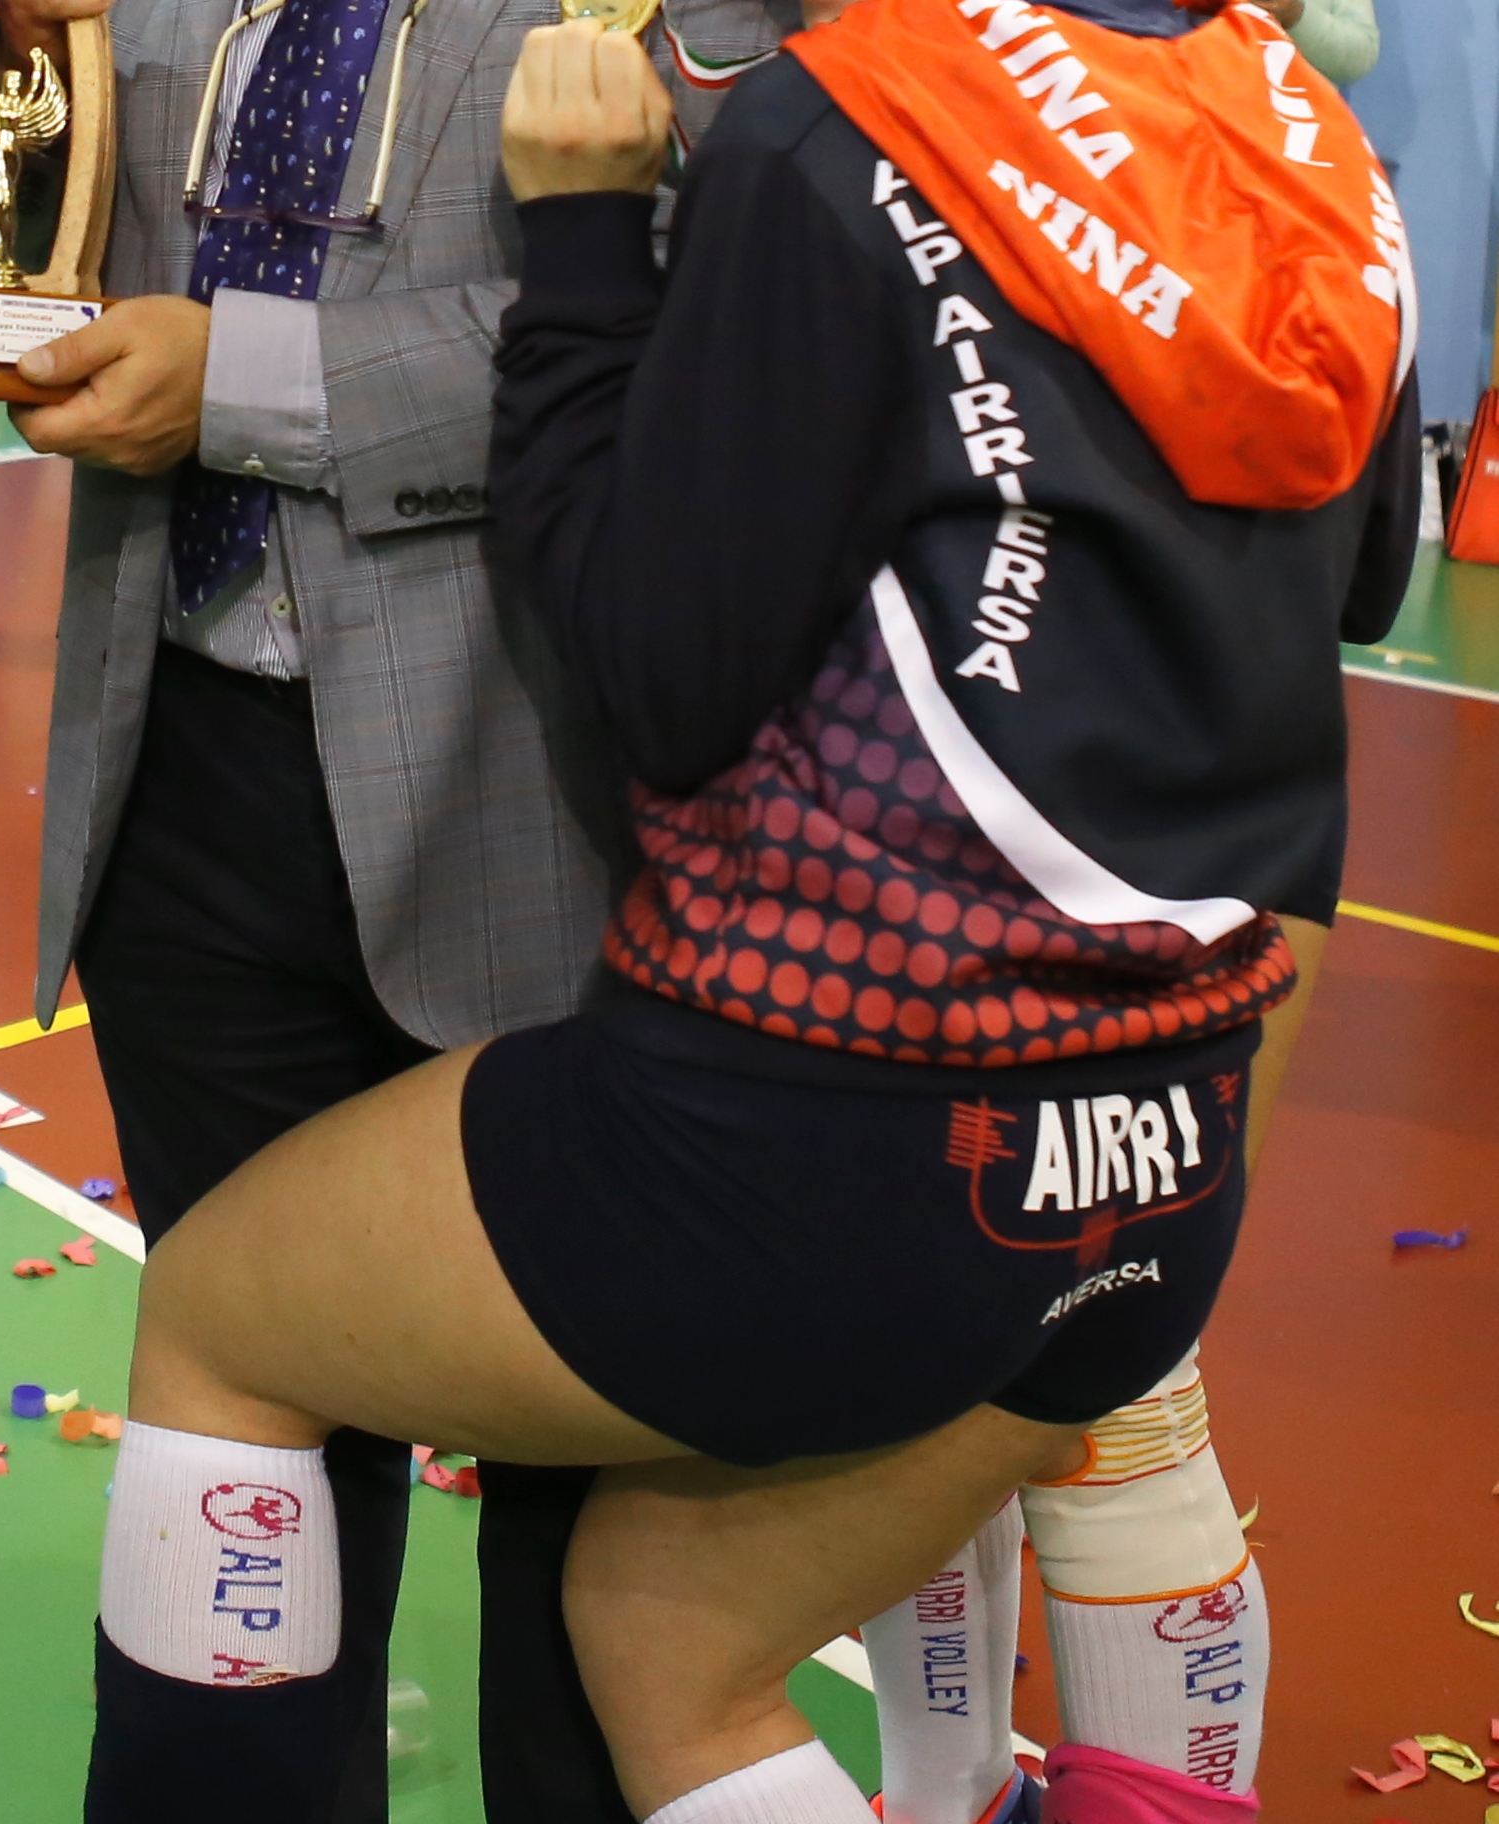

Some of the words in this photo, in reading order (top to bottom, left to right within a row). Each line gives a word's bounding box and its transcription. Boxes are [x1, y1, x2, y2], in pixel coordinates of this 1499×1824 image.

[872, 159, 963, 286] ALP
[987, 158, 1194, 340] NINA
[1040, 1257, 1162, 1325] AVERSA
[212, 1546, 283, 1632] ALP
[921, 1630, 969, 1717] VOLLEY
[1184, 1639, 1248, 1705] ALP
[1187, 1721, 1240, 1792] AIRR
